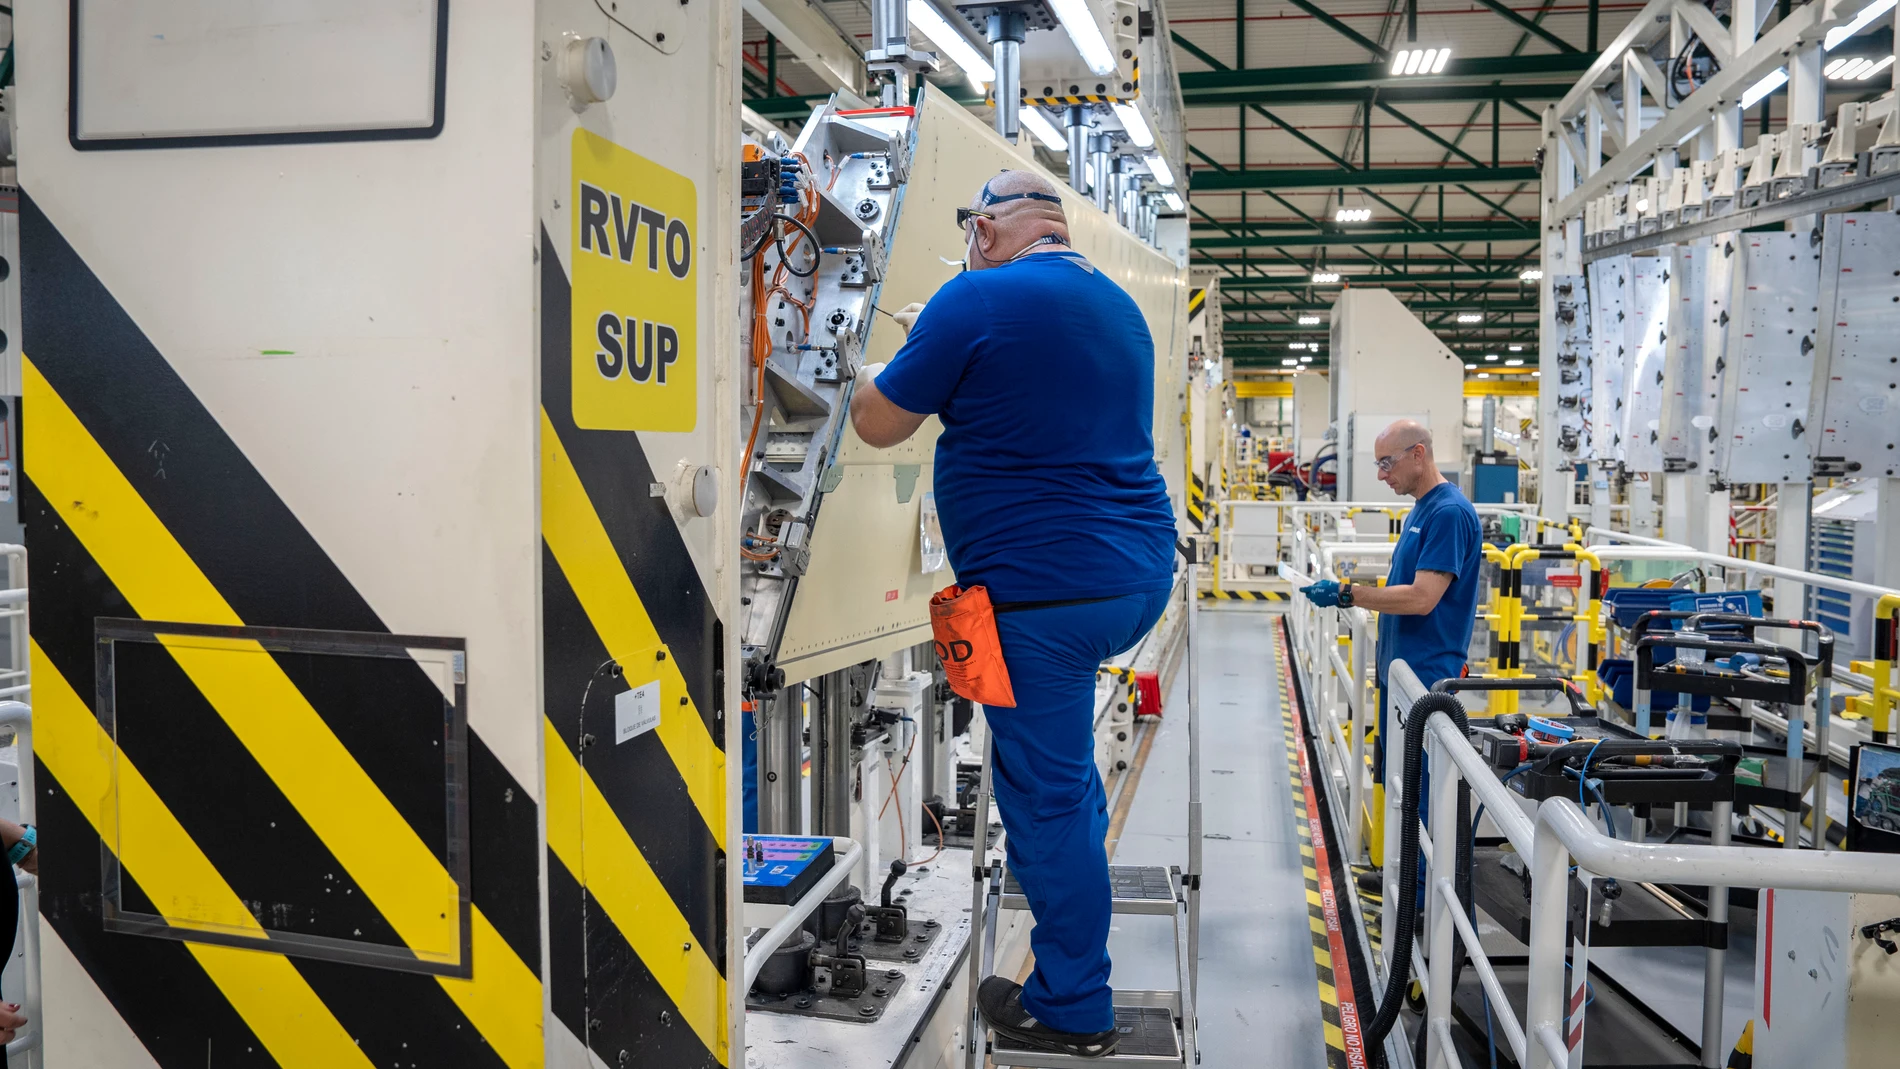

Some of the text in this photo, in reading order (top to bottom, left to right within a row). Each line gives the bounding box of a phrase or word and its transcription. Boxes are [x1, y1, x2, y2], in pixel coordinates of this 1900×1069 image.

[579, 180, 692, 279] RVTO
[596, 311, 679, 385] SUP
[934, 640, 973, 662] OD
[1341, 1001, 1358, 1033] PELIGRO
[1346, 1033, 1361, 1047] NO
